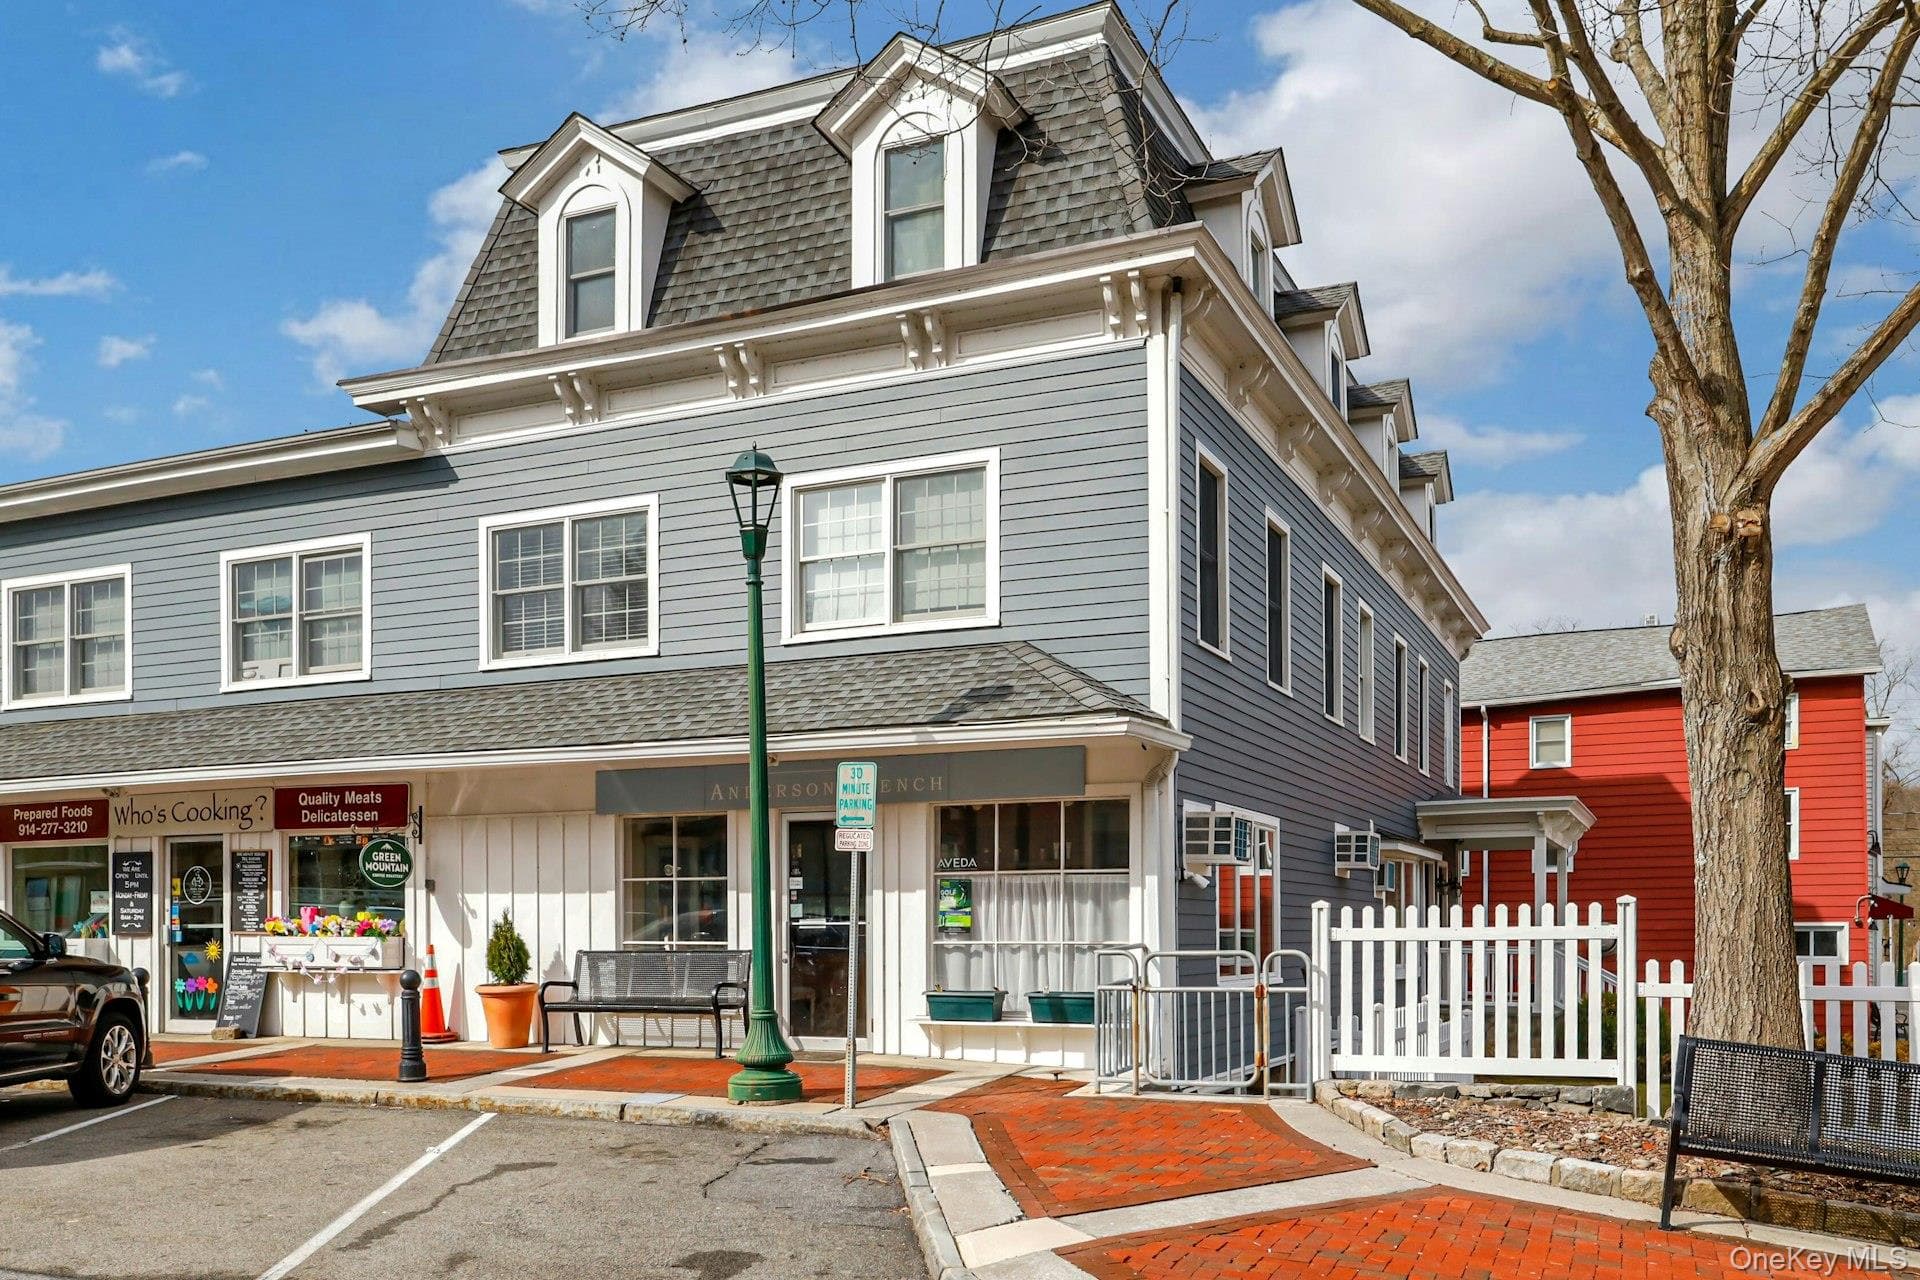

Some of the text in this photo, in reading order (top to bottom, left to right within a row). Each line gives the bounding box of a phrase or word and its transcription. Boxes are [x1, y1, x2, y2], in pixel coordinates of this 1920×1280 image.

[850, 767, 863, 779] 30
[842, 783, 871, 795] MINUTE
[298, 791, 382, 807] Quality Meats
[840, 799, 873, 810] PARKING
[13, 805, 93, 822] Prepared Foods
[114, 792, 267, 830] Who's Cooking?
[301, 809, 379, 823] Delicatessen
[18, 820, 88, 836] 914-277-3210
[858, 840, 869, 848] ZONE
[372, 851, 402, 863] GREEN
[937, 857, 978, 868] AVEDA
[365, 861, 409, 873] MOUNTAIN
